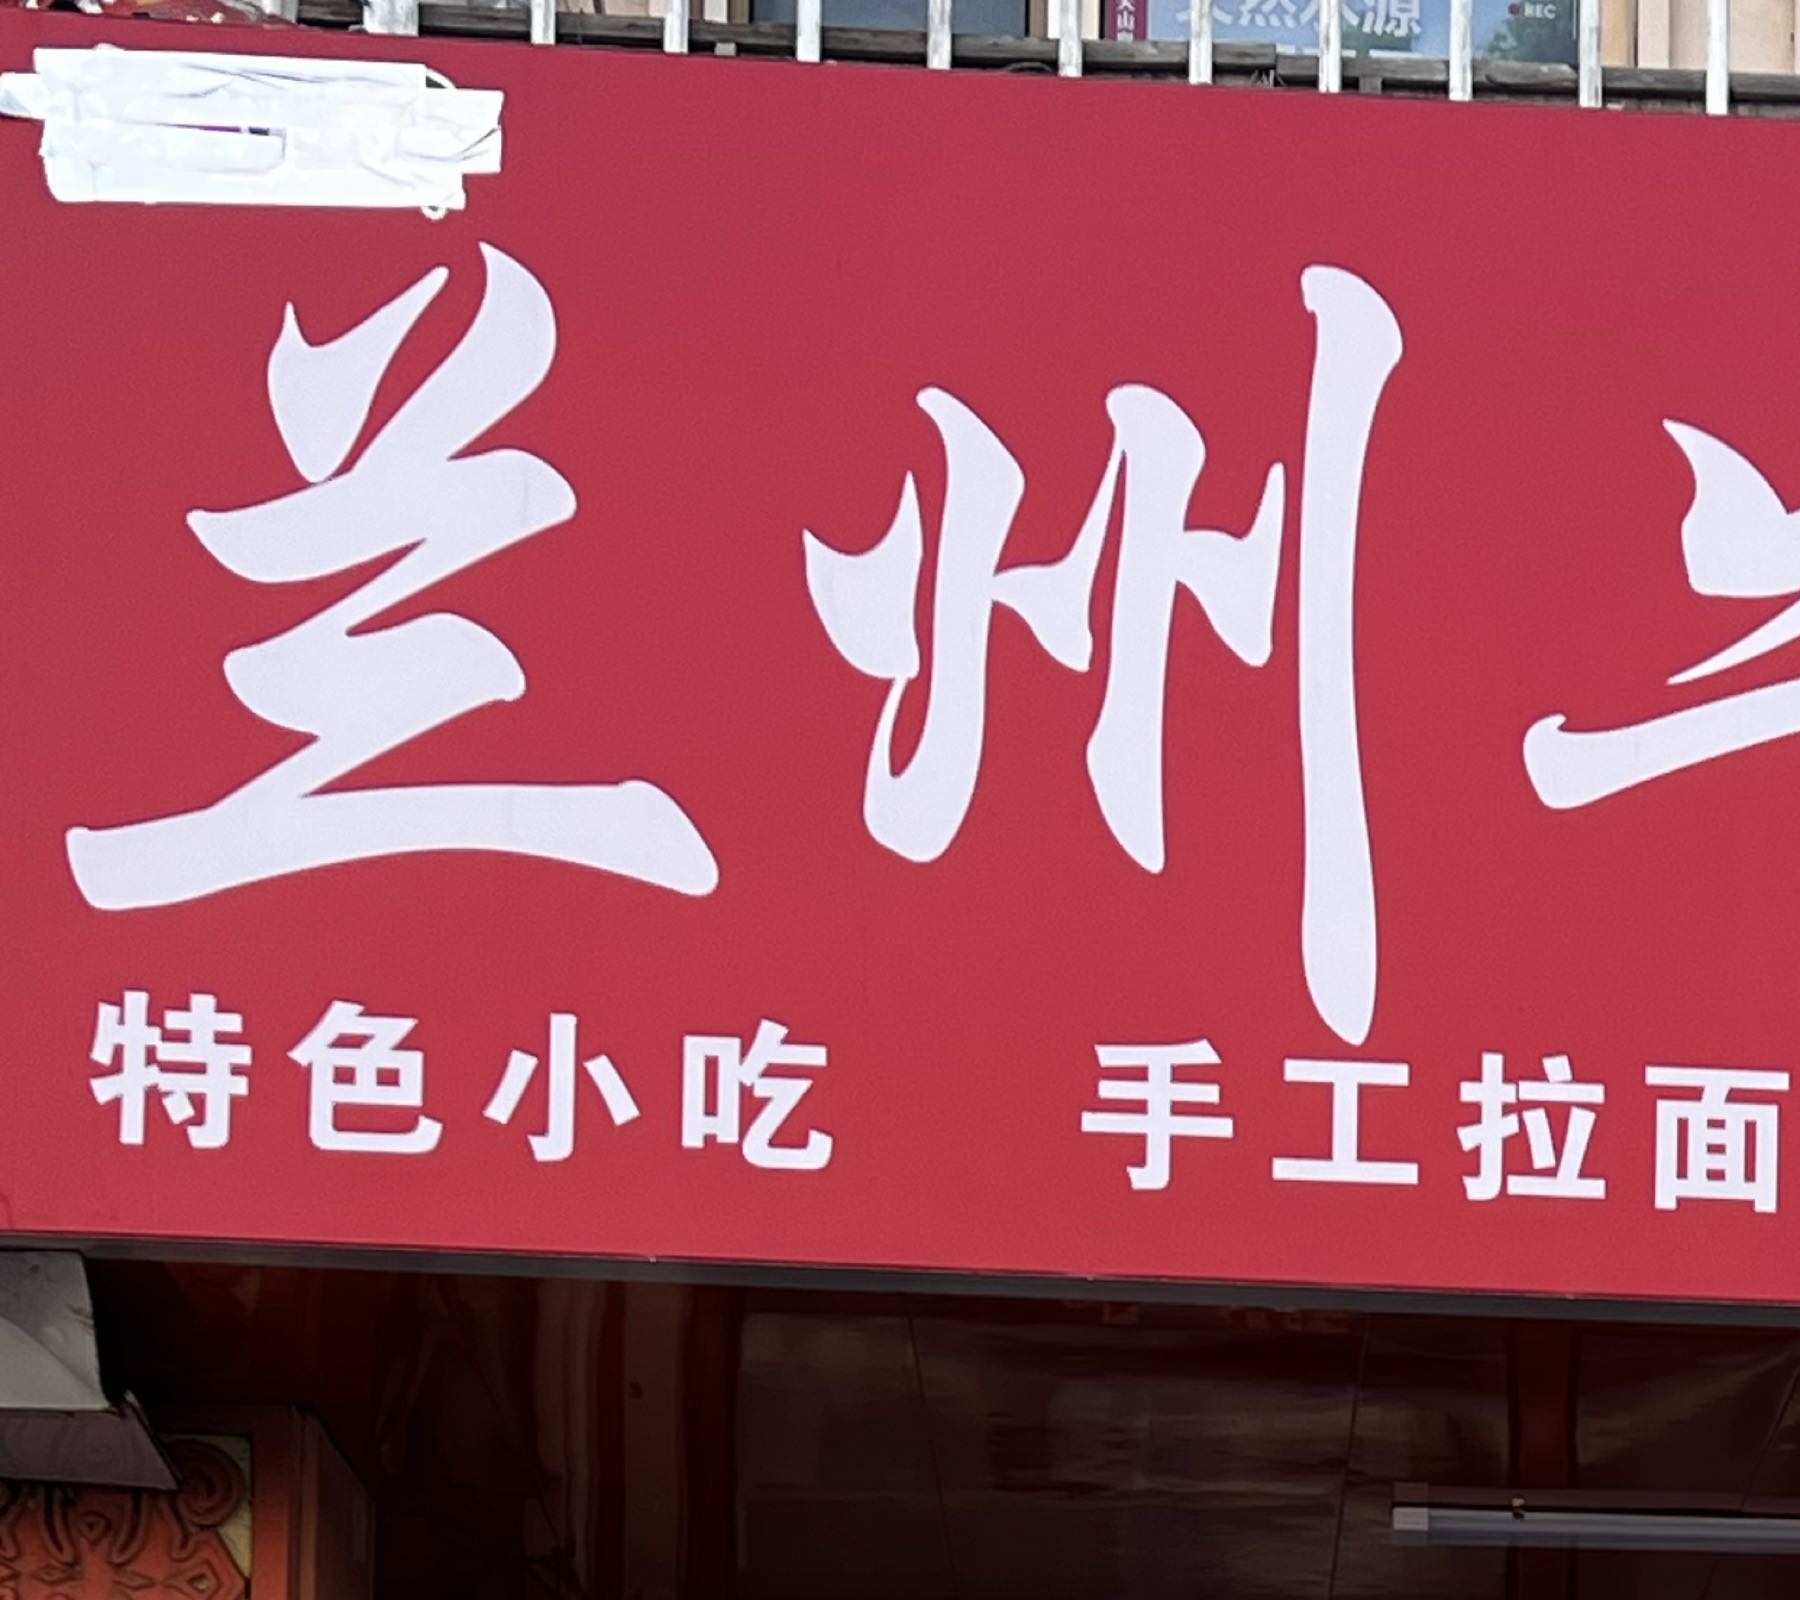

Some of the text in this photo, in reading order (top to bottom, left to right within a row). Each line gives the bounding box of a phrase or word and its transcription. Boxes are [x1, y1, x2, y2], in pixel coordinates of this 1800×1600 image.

[90, 989, 833, 1171] 特色小吃
[1081, 1039, 1788, 1213] 手工拉面
